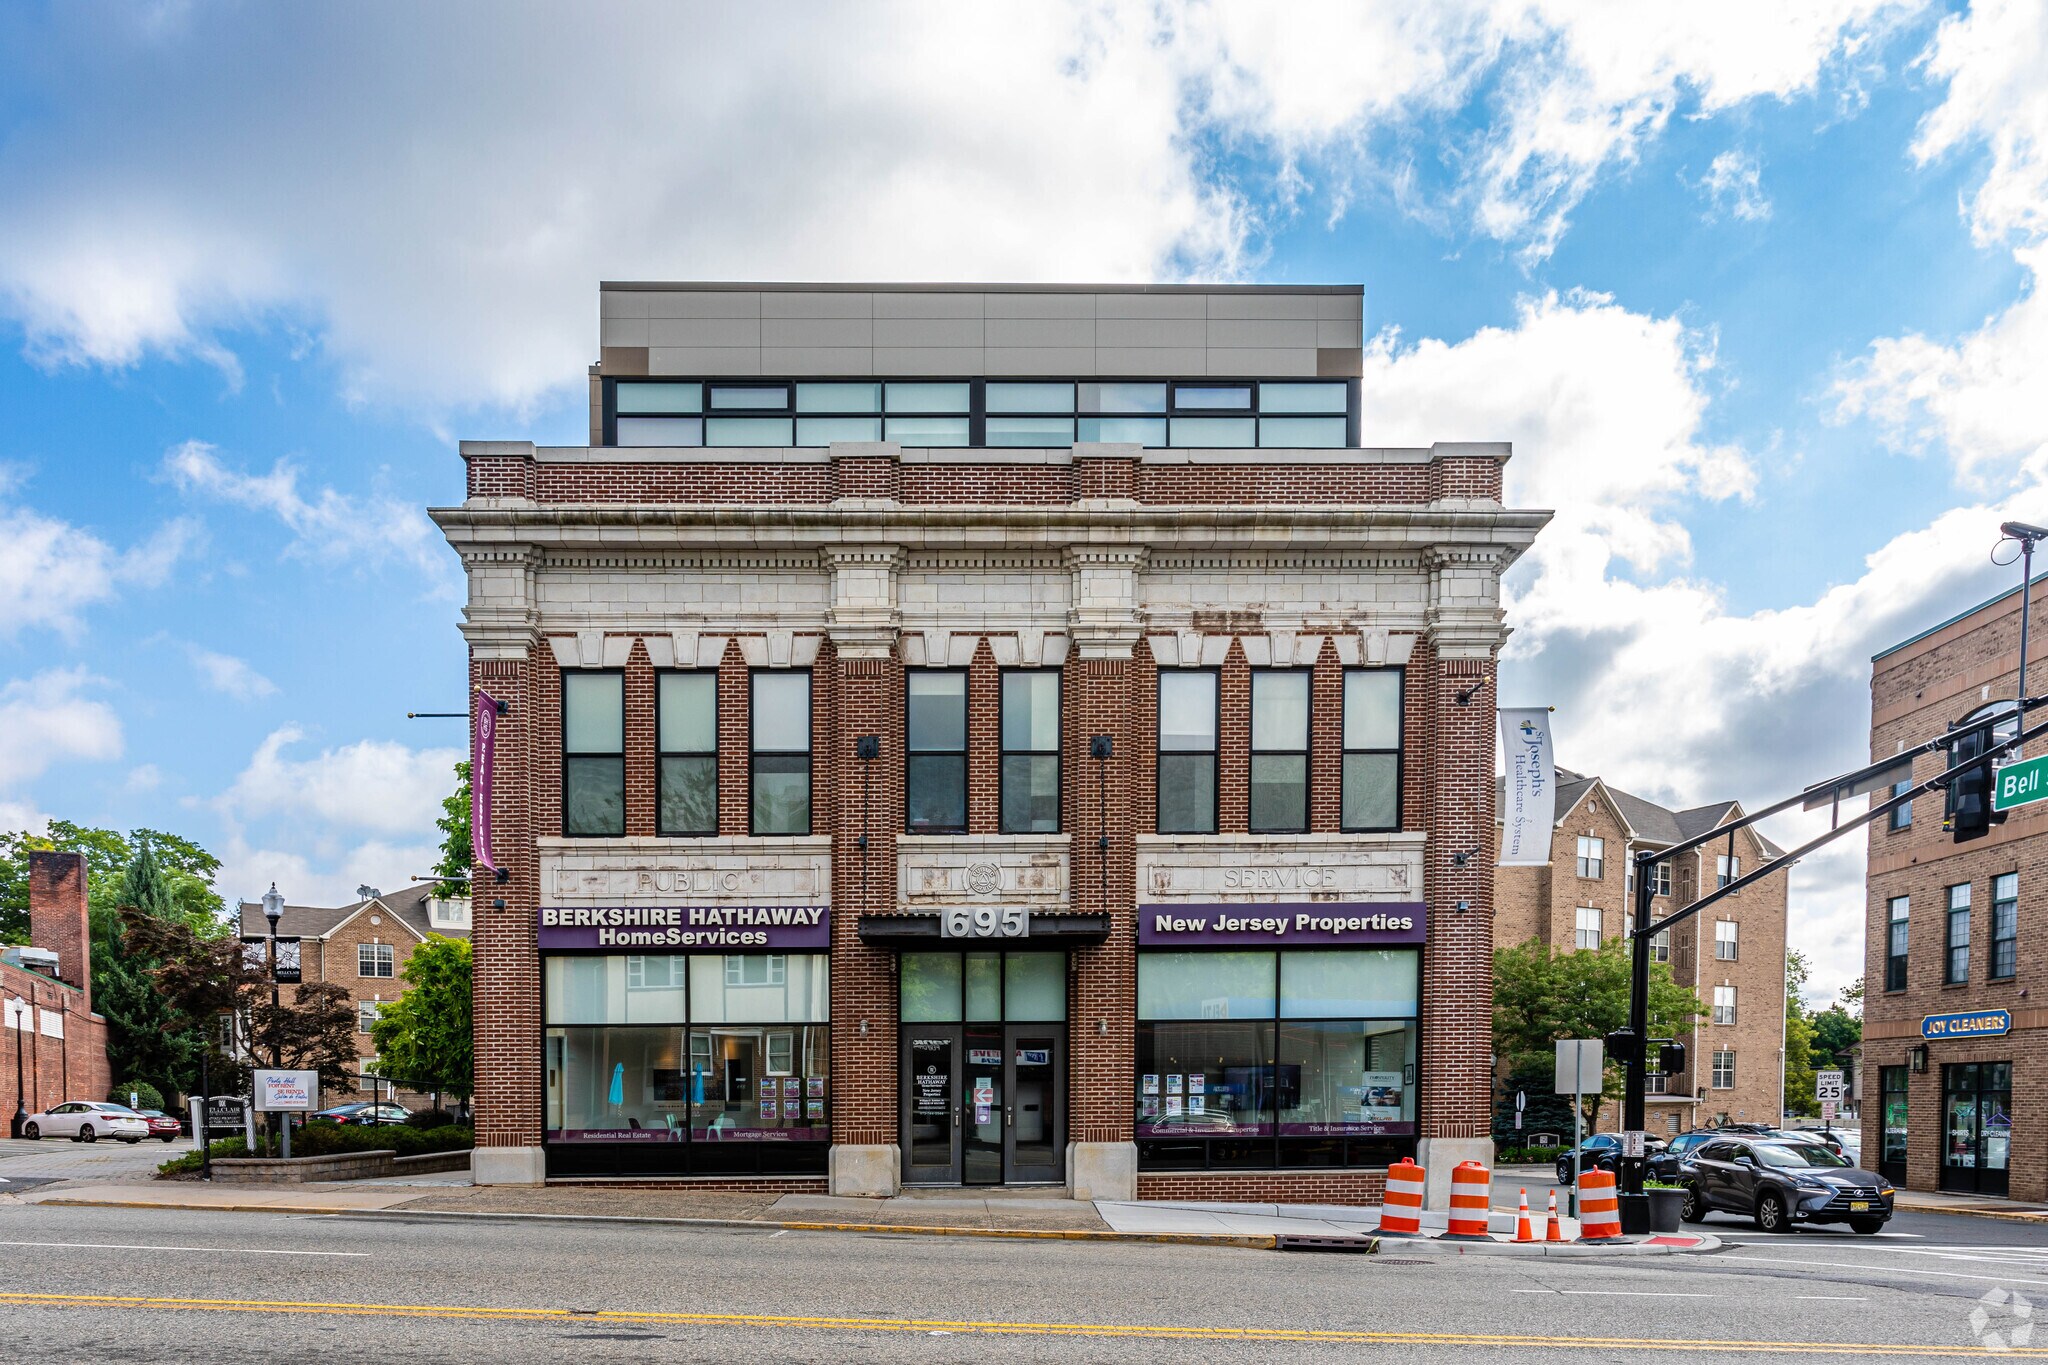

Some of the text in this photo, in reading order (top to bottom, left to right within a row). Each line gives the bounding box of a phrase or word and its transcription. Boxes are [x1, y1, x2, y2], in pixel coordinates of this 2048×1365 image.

[2003, 768, 2039, 798] Bell
[1511, 754, 1527, 855] Healthcare System
[638, 872, 739, 892] PUBLIC
[1224, 868, 1337, 888] SERVICE
[542, 908, 824, 926] BERKSHIRE HATHAWAY
[947, 907, 1024, 937] 695
[1155, 913, 1413, 935] New Jersey Properties
[599, 928, 768, 945] HomeServices
[1926, 1016, 2005, 1034] JOY CLEANERS
[1819, 1087, 1840, 1098] 25
